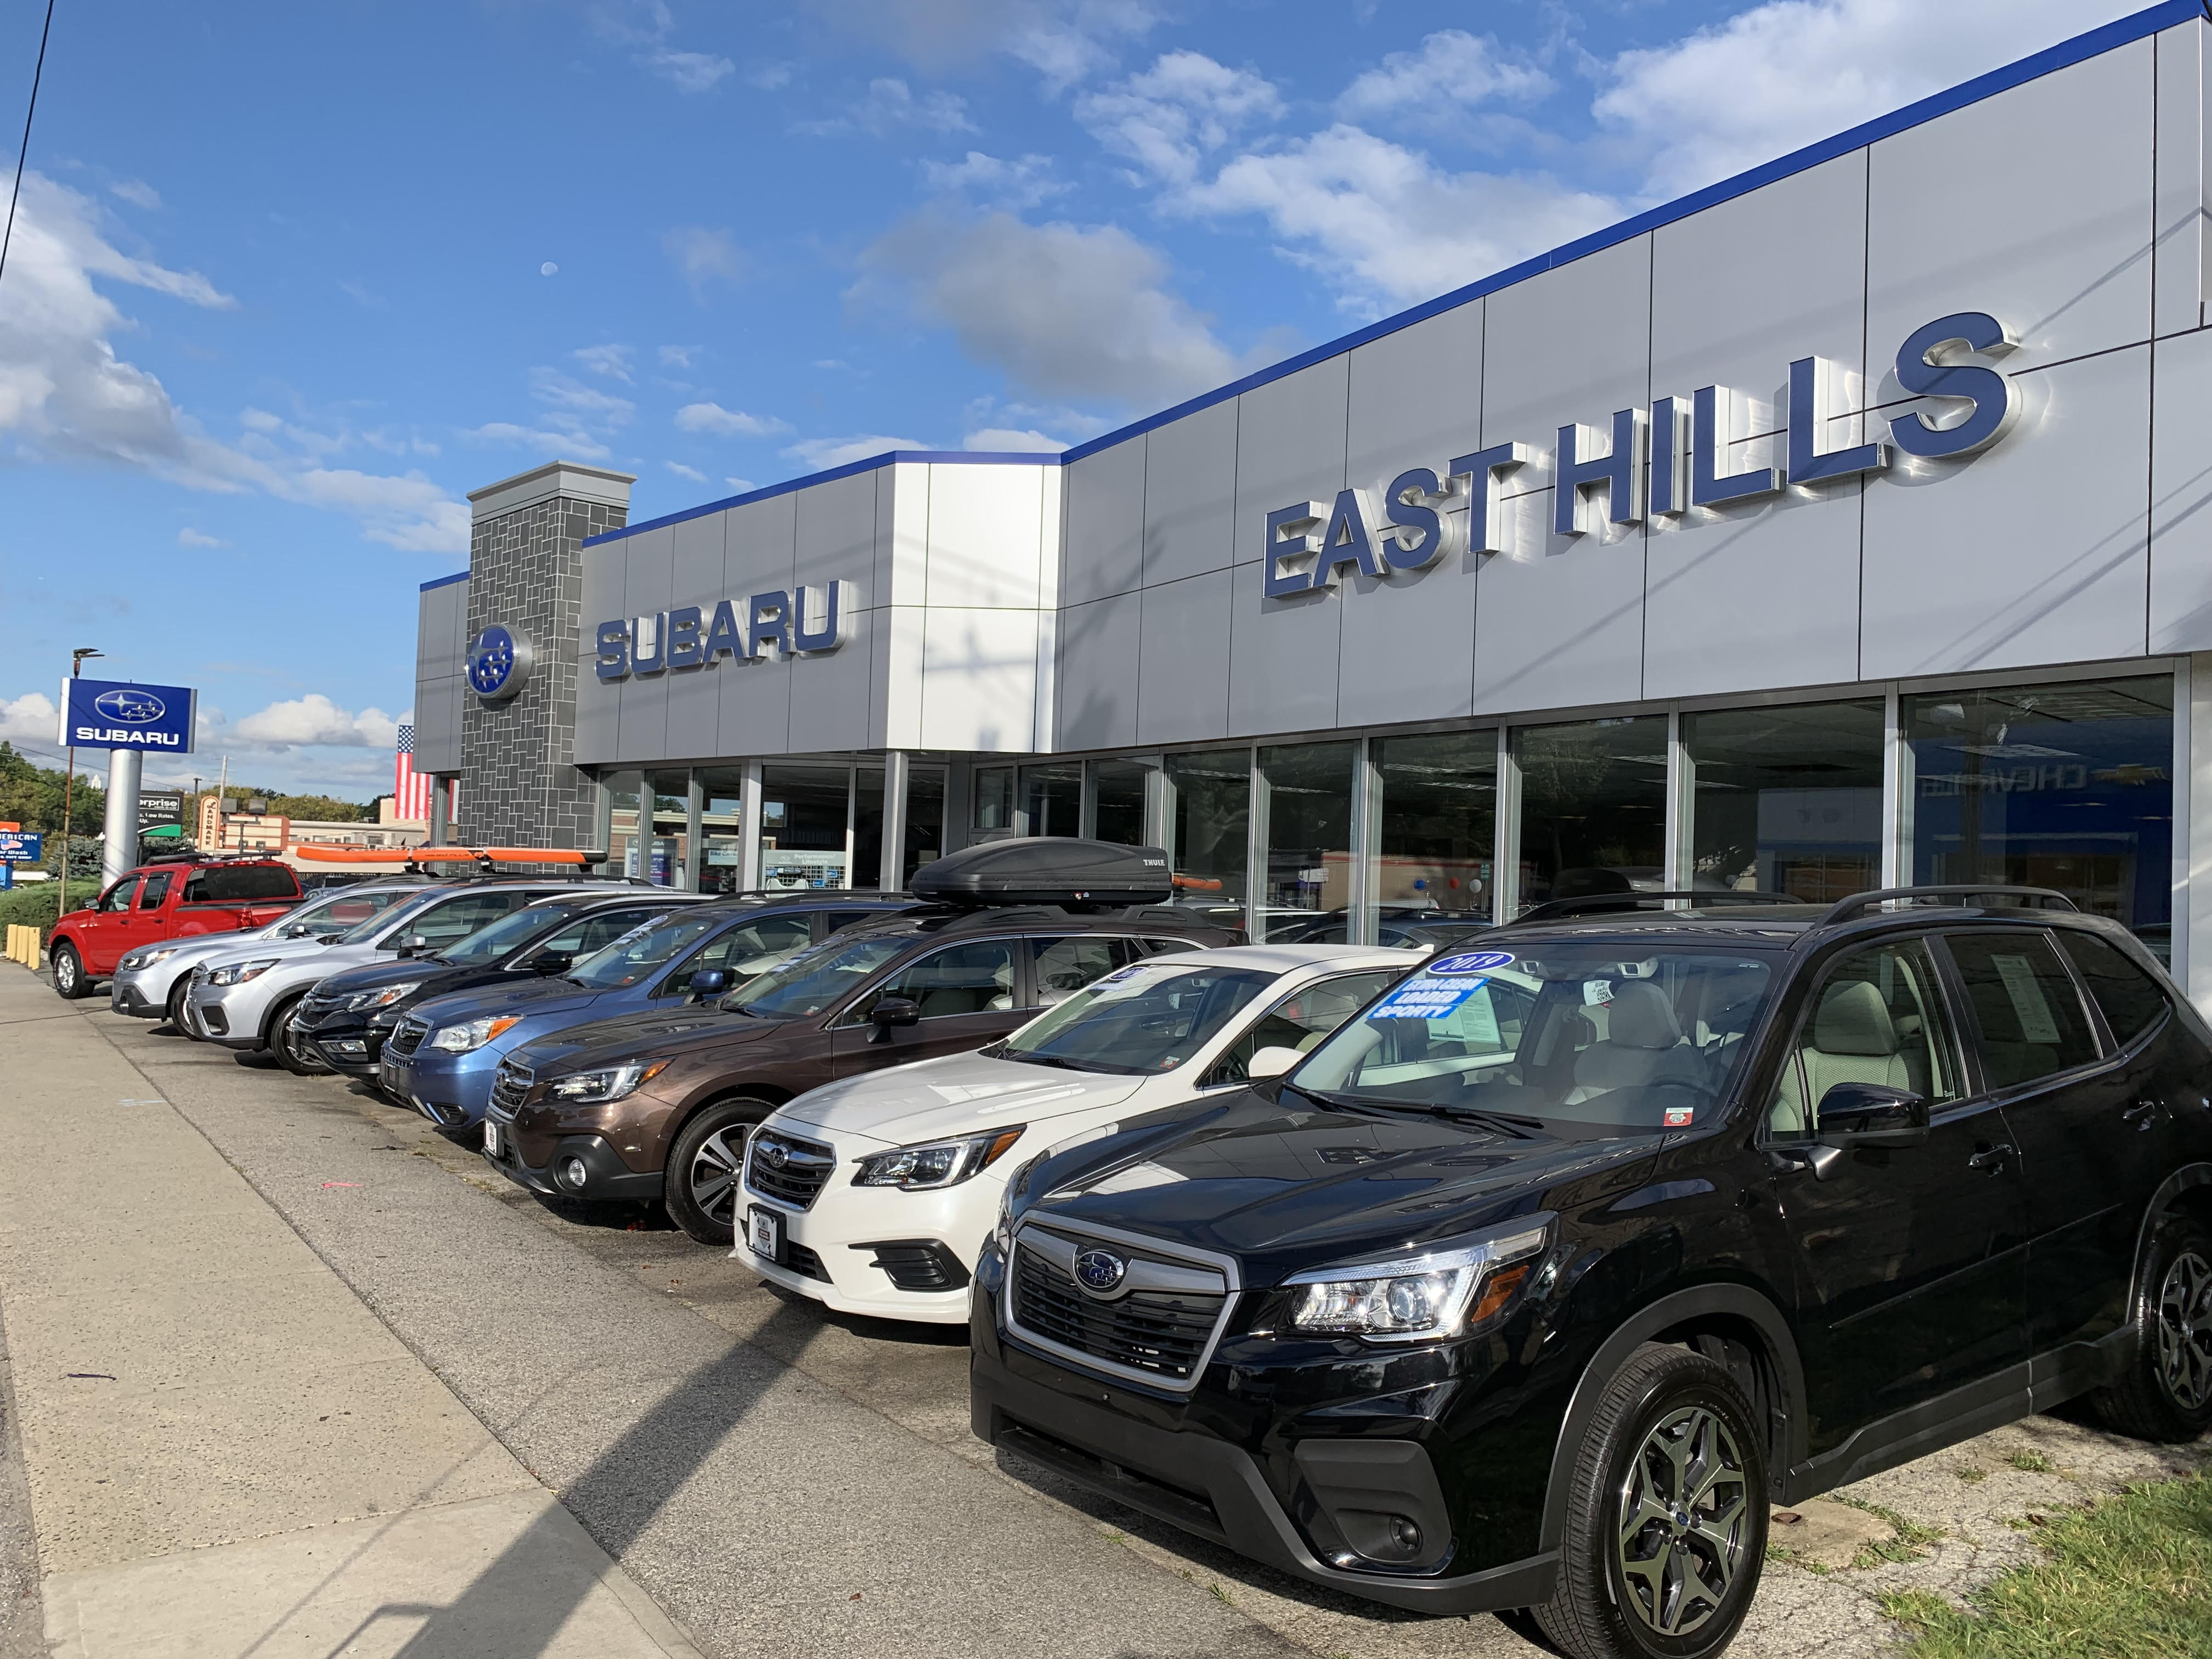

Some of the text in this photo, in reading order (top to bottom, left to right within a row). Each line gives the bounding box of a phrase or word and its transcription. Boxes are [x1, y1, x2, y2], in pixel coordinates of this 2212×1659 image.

[1263, 312, 2018, 598] EAST HILLS
[595, 580, 845, 679] SUBARU
[76, 727, 179, 745] SUBARU
[205, 802, 216, 845] LANDMARK
[1435, 955, 1504, 971] 2019
[1393, 991, 1462, 1004] LOADED
[1373, 1005, 1452, 1018] SPORTY
